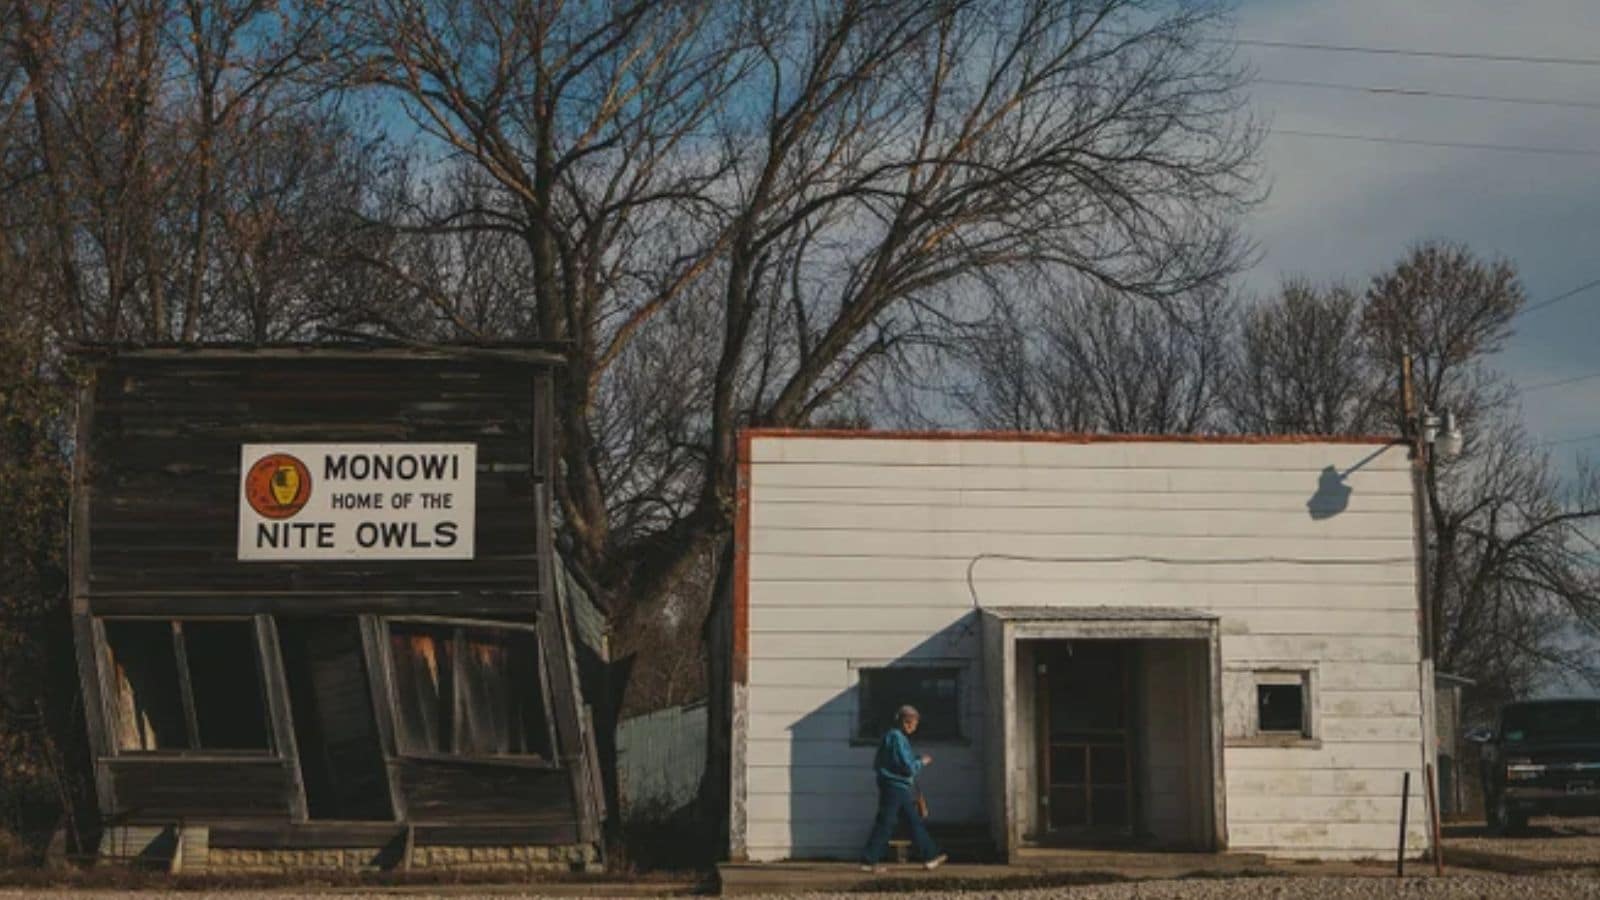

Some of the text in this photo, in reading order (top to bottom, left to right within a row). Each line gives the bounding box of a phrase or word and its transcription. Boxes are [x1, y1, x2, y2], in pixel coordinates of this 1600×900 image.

[324, 455, 459, 480] MONOWI
[331, 493, 453, 509] HOME OF THE
[256, 521, 458, 548] NITE OWLS
